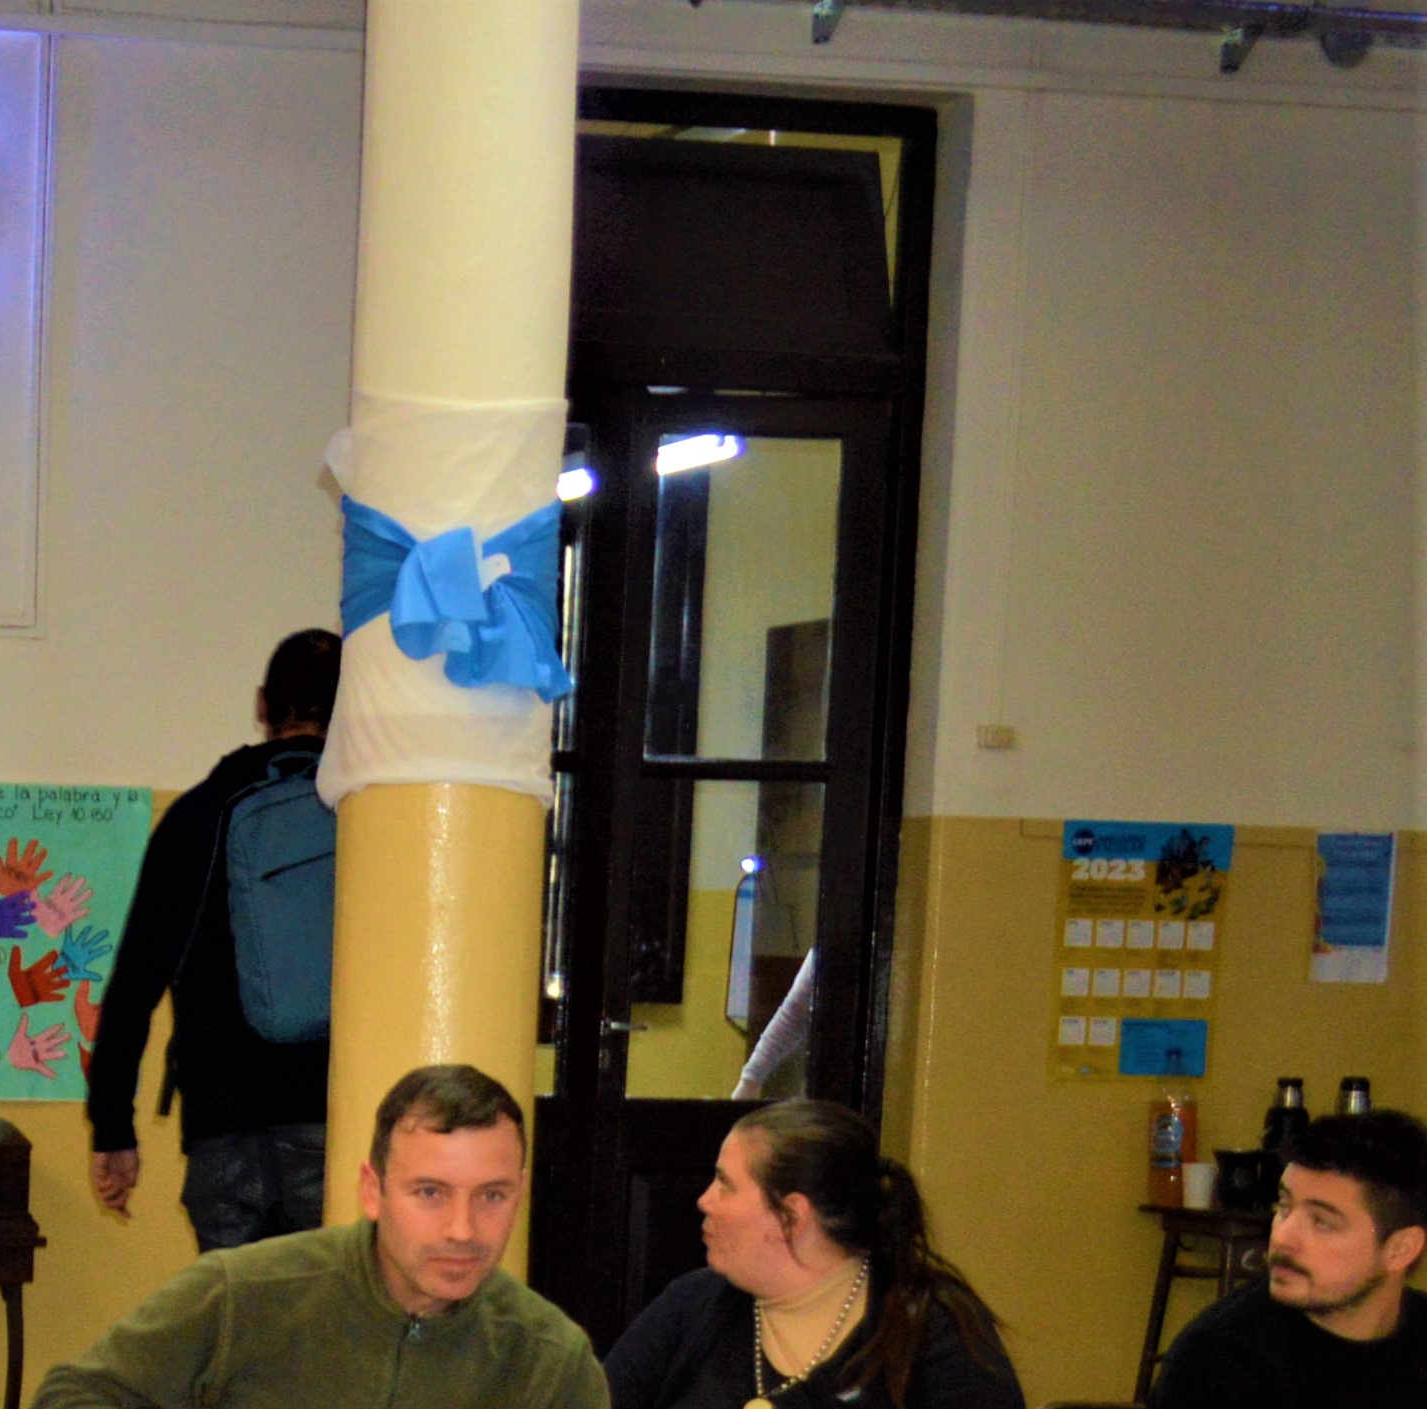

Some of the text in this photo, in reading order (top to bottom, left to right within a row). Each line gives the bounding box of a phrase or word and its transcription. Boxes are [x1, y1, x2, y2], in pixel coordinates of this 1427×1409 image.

[14, 783, 31, 800] la
[37, 785, 101, 807] palabra
[112, 790, 122, 810] y
[32, 805, 63, 825] Ley
[1071, 857, 1146, 881] 2023
